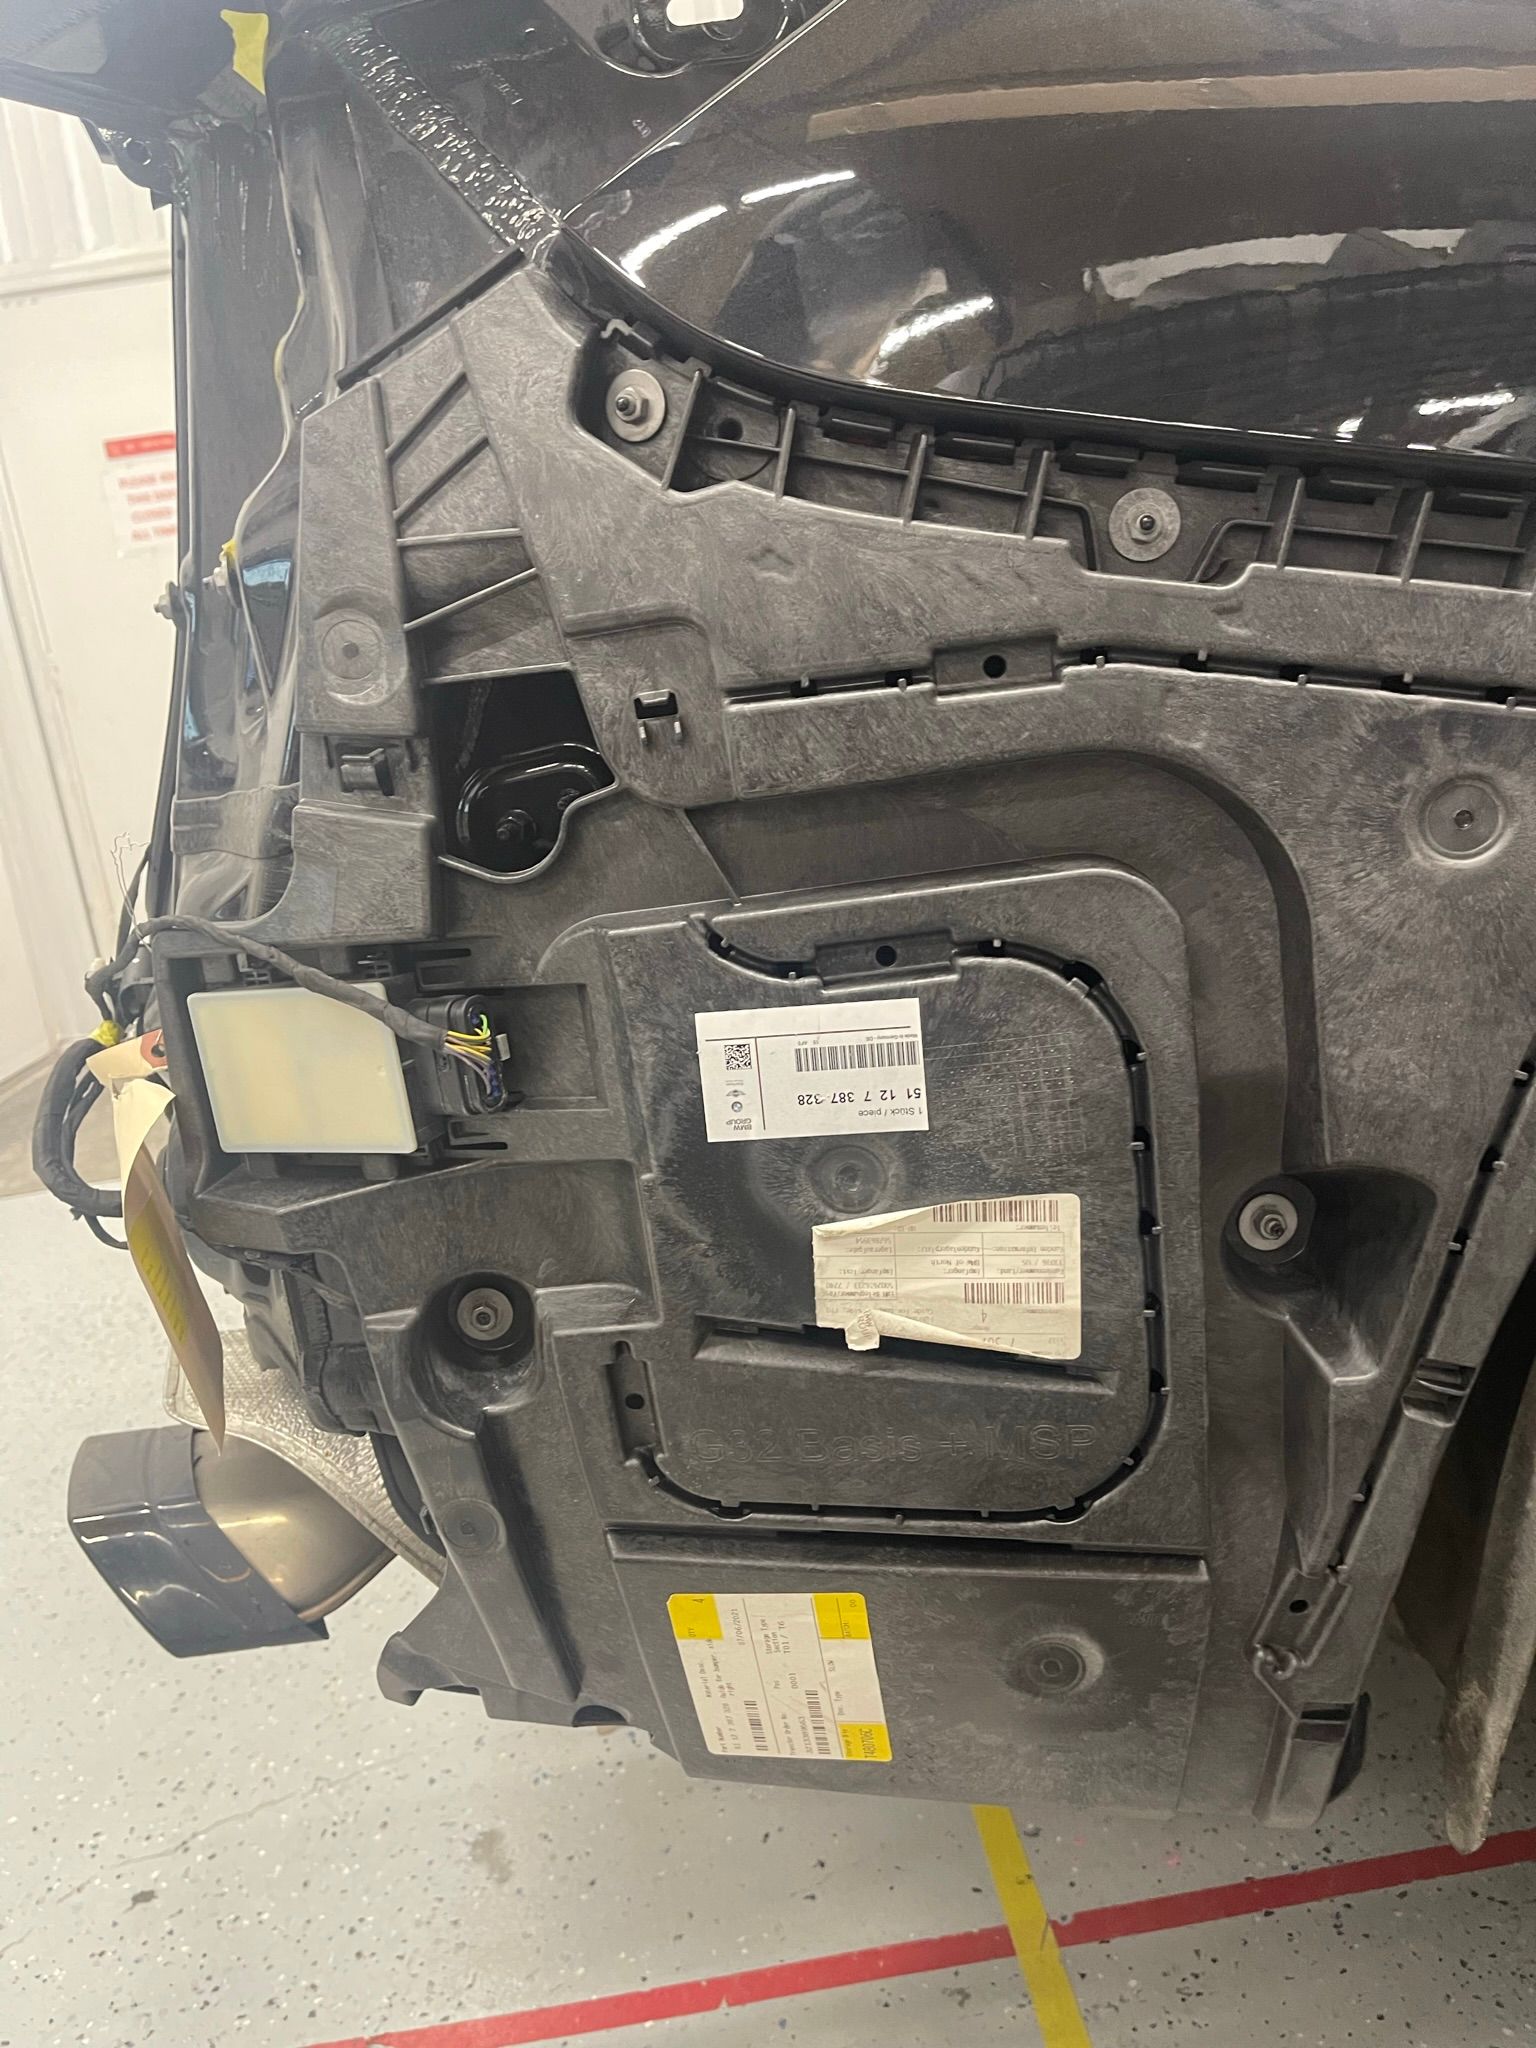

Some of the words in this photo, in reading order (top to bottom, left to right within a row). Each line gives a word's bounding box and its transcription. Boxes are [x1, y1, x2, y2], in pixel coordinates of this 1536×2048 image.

[829, 1091, 854, 1103] 387
[863, 1090, 871, 1101] 7
[879, 1089, 896, 1100] 12
[905, 1087, 921, 1099] 51
[797, 1093, 821, 1105] 328
[857, 1107, 881, 1117] piece
[889, 1107, 914, 1116] Stück
[918, 1106, 922, 1114] 1
[725, 1117, 751, 1125] GROUP
[689, 1428, 783, 1464] G32
[795, 1427, 922, 1464] Basis
[939, 1431, 969, 1457] +
[983, 1424, 1097, 1462] MSP
[788, 1672, 799, 1689] 0001
